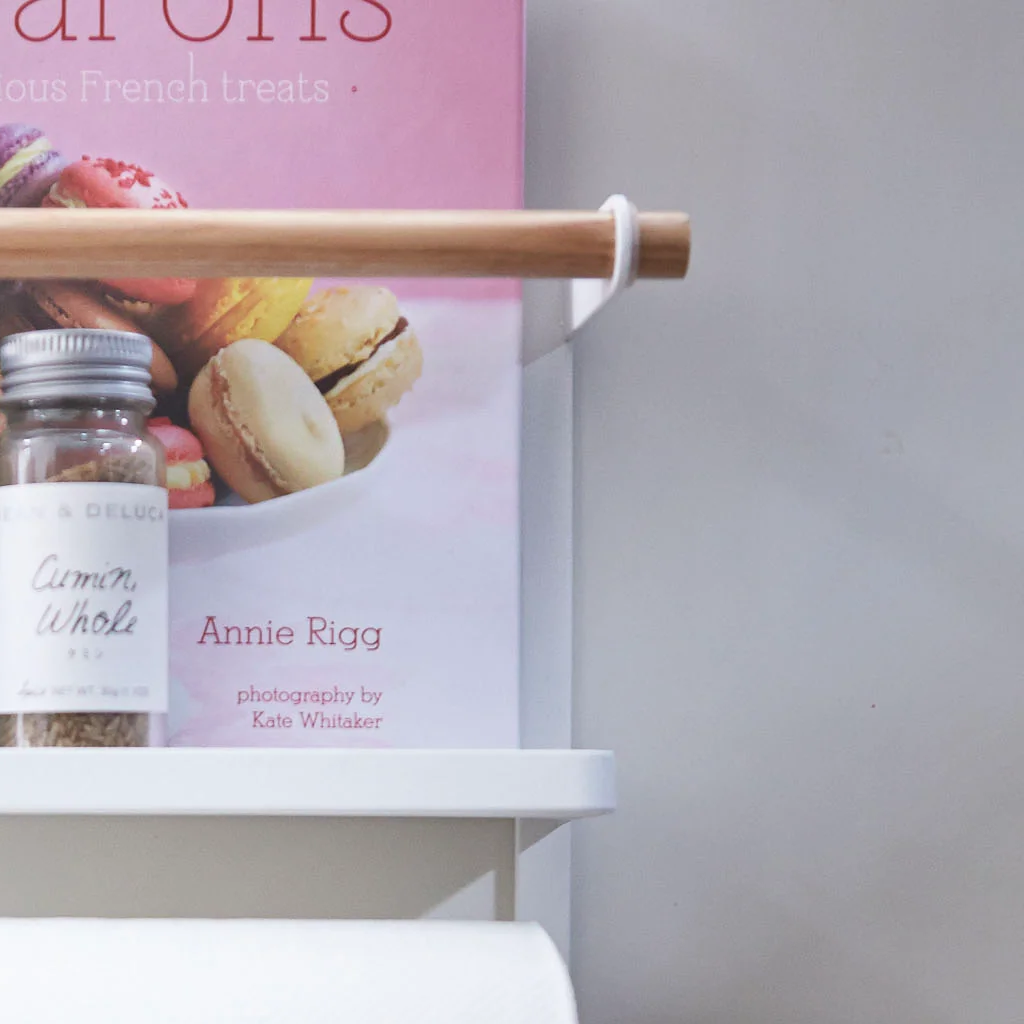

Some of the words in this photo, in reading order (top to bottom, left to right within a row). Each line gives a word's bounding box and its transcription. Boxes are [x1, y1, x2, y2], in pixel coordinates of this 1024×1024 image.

[79, 51, 207, 103] French
[221, 70, 330, 103] treats
[36, 599, 138, 636] Whole
[197, 615, 294, 646] Annie
[306, 616, 383, 651] Rigg
[237, 684, 355, 706] photography
[360, 685, 383, 706] by
[252, 710, 293, 729] Kate
[299, 711, 383, 730] Whitaker
